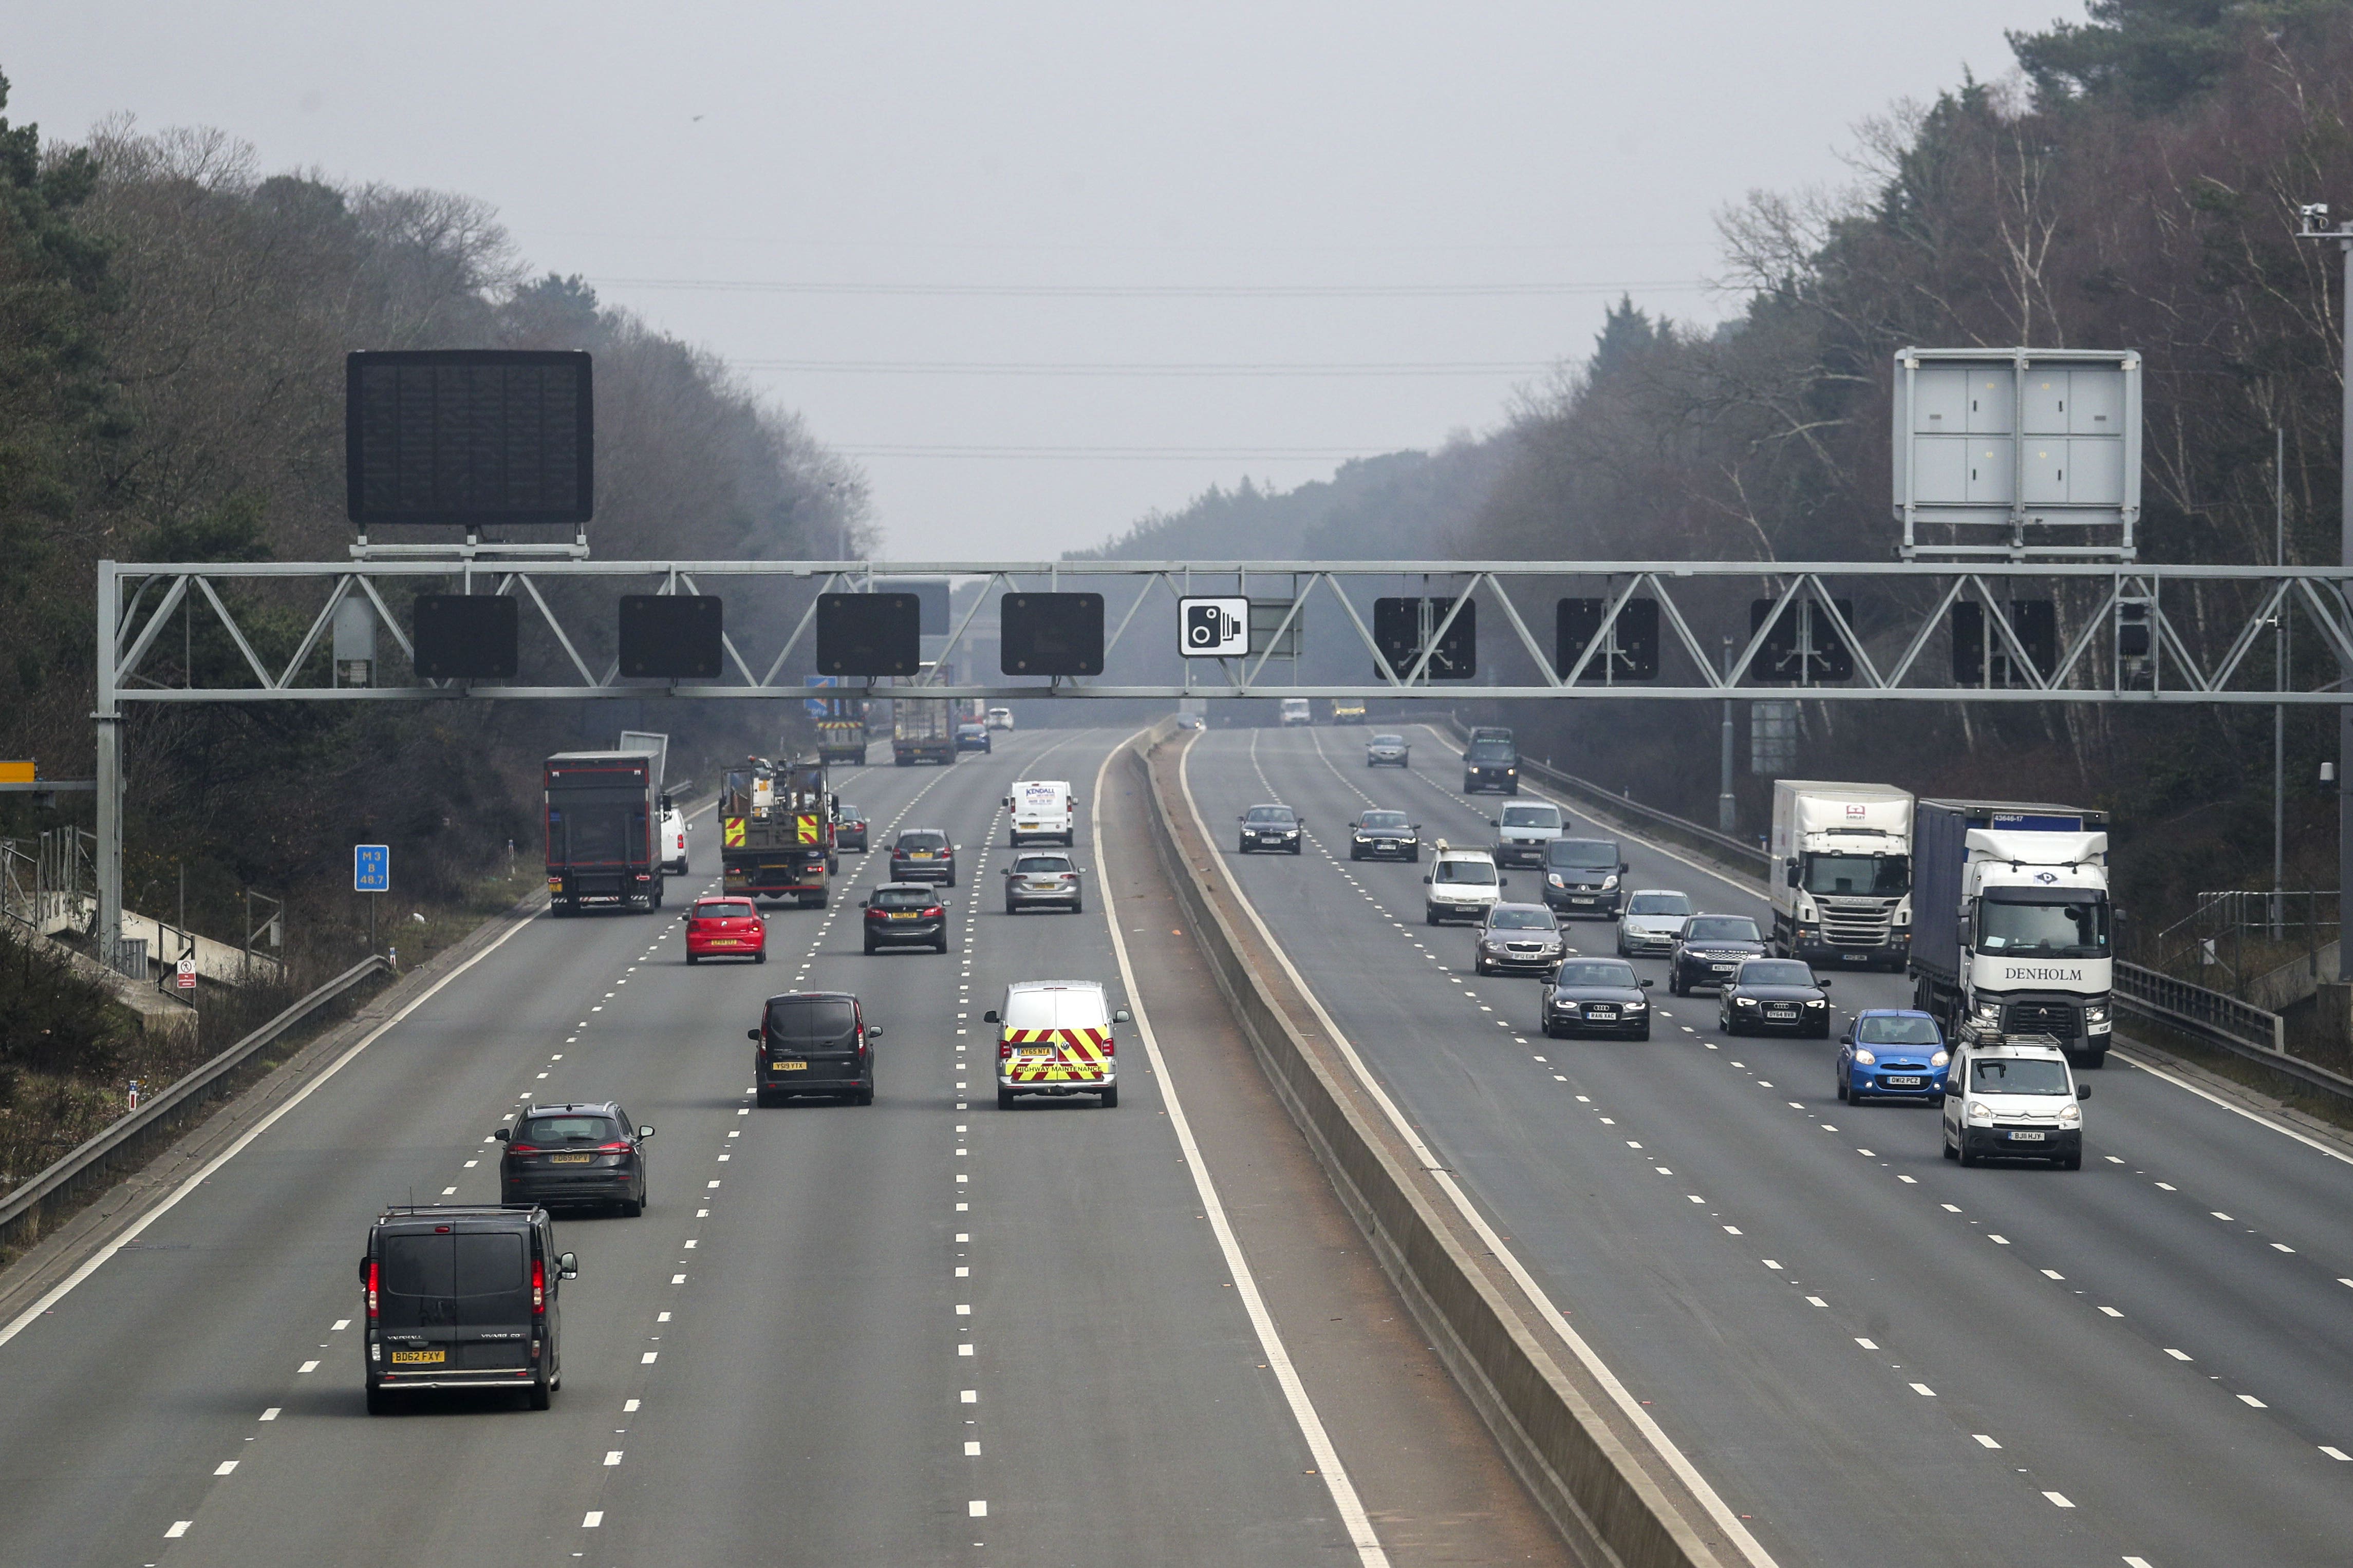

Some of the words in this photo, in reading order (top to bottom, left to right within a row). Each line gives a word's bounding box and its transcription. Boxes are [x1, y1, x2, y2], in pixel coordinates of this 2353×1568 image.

[368, 864, 375, 873] B
[360, 875, 384, 884] 48.7
[2006, 968, 2082, 981] DENHOLM
[396, 1352, 420, 1361] BD62
[422, 1352, 440, 1361] FXY
